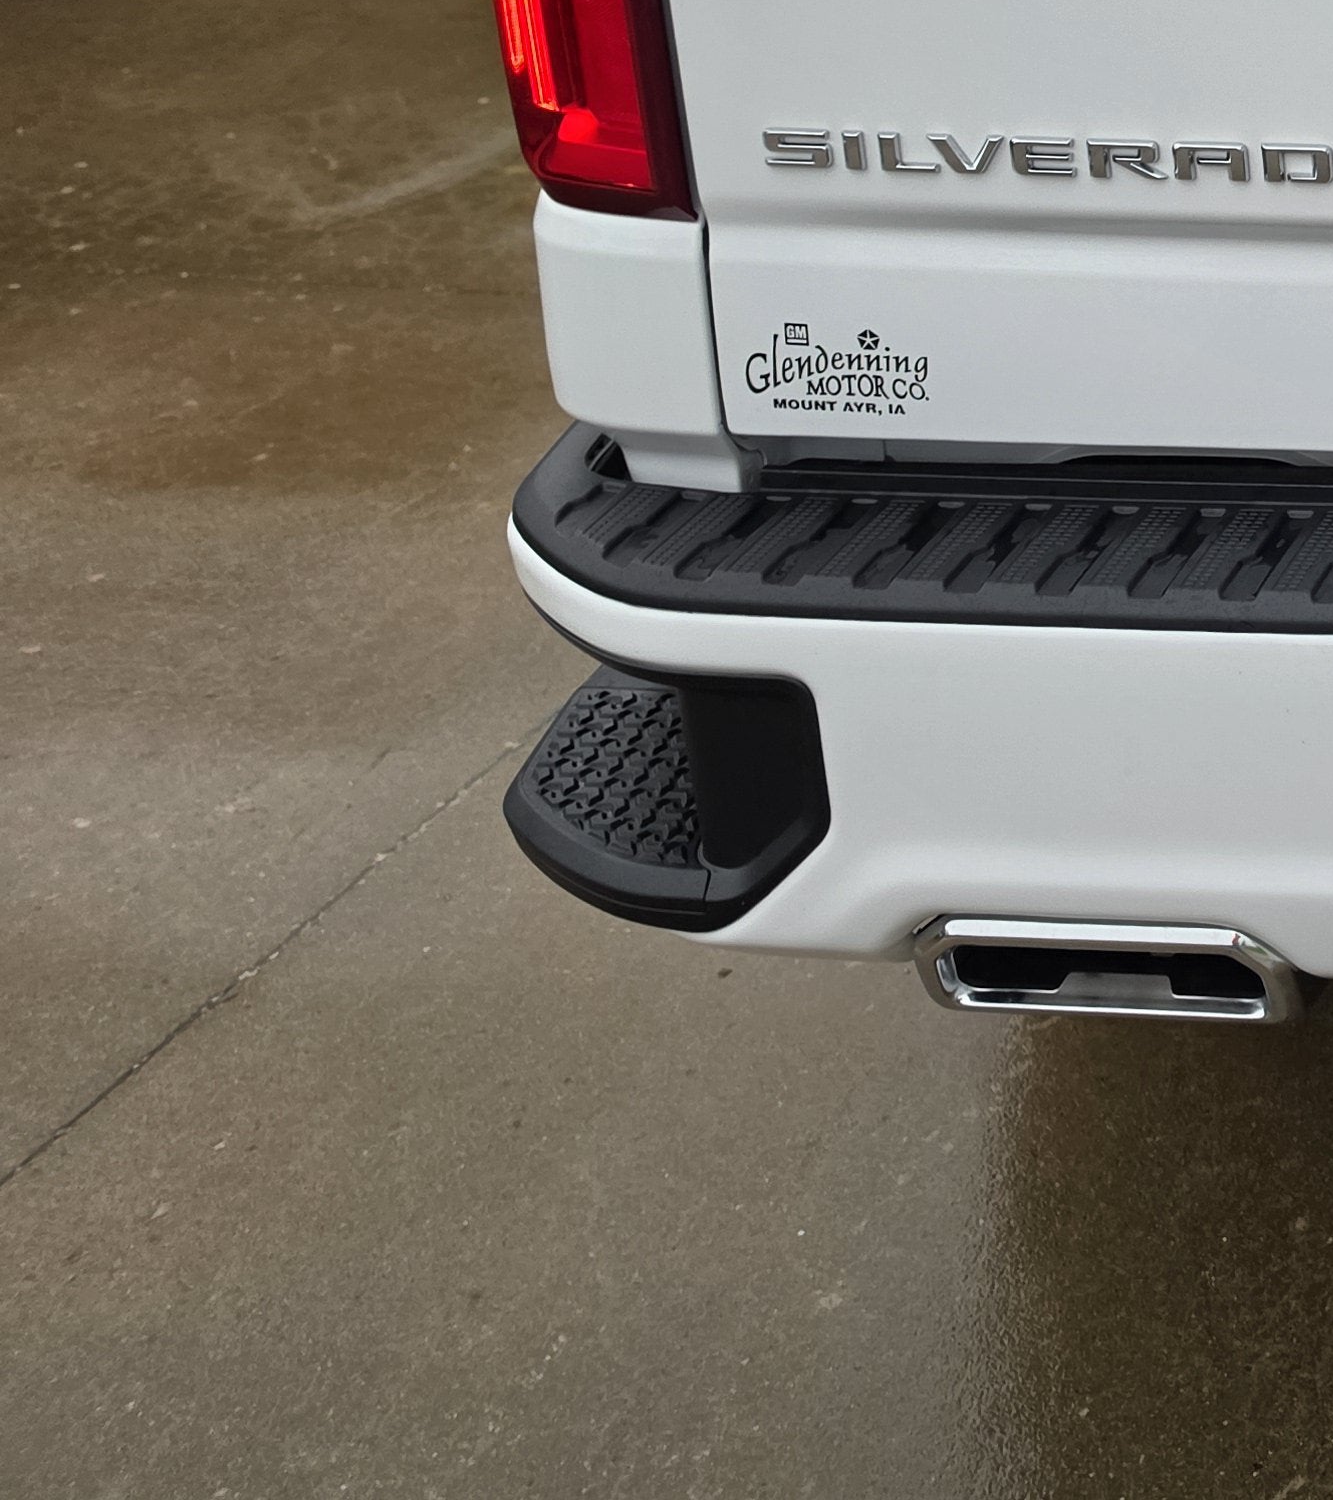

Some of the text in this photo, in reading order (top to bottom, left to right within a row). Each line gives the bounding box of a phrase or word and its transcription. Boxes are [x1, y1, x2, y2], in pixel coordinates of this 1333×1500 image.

[745, 333, 929, 395] Glendenning
[805, 373, 931, 402] MOTOR CO.
[773, 397, 906, 417] MOUNT AYR, IA
